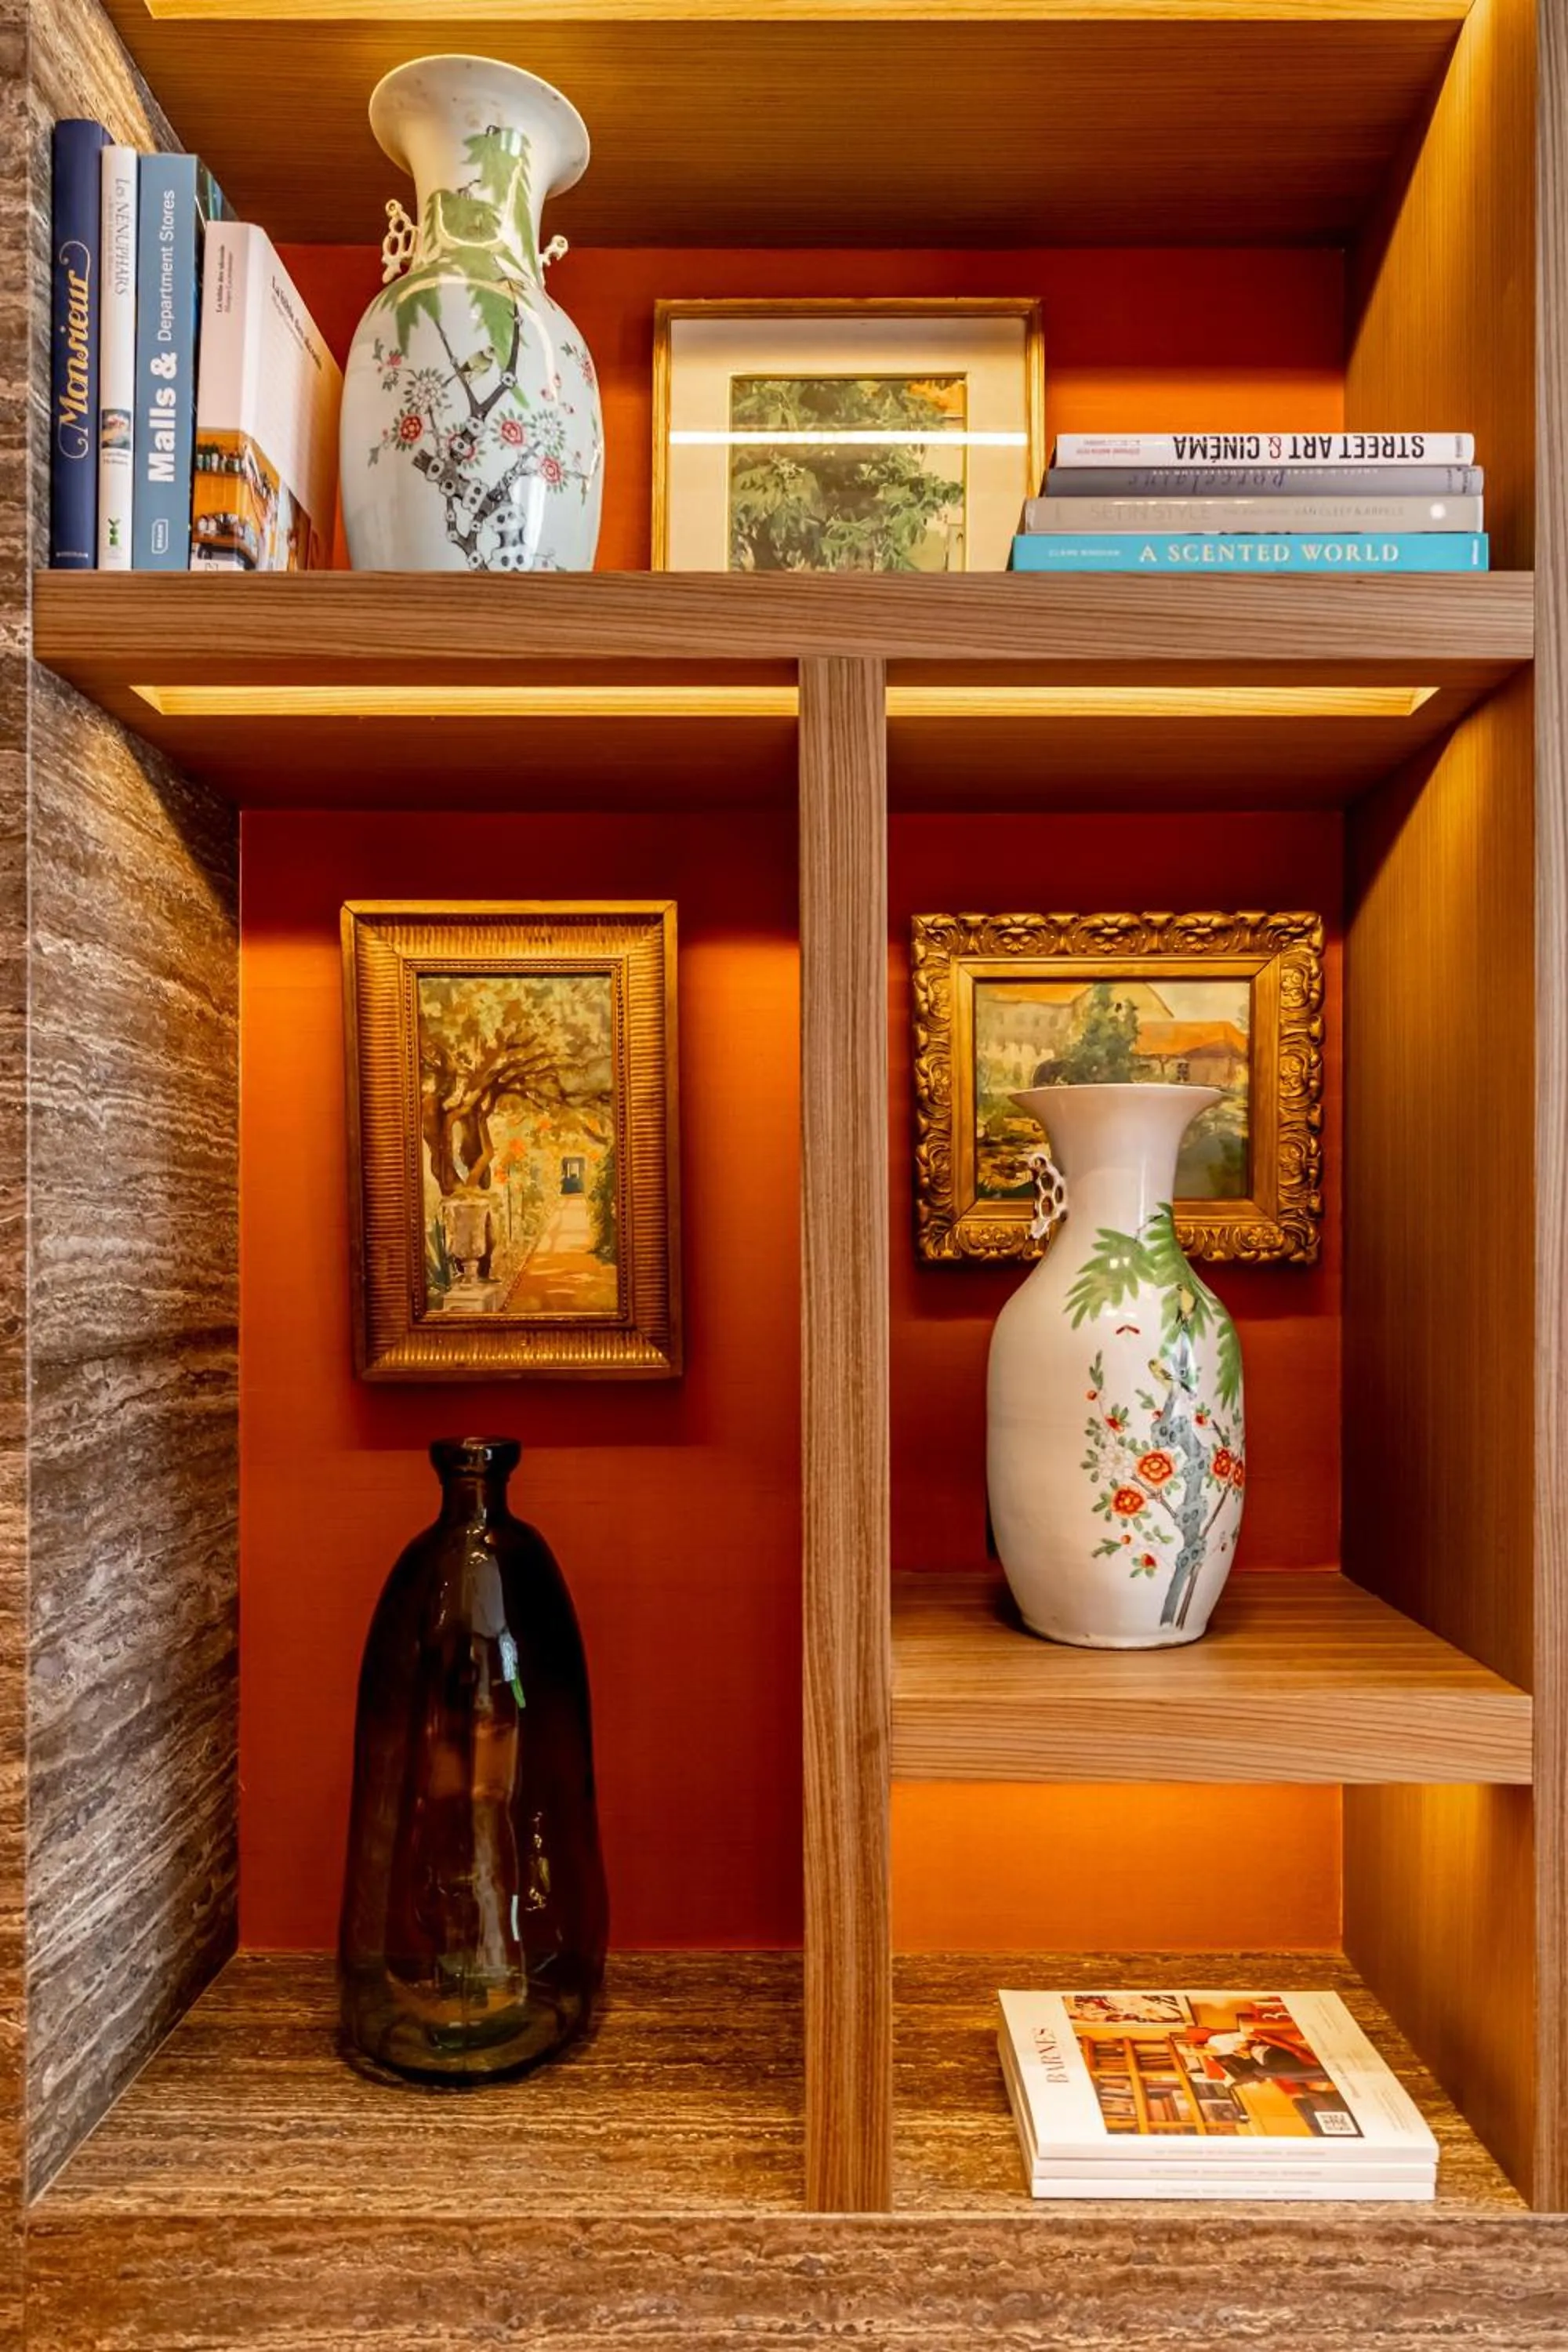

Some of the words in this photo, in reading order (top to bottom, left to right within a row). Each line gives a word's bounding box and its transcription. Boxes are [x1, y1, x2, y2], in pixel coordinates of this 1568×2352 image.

[159, 189, 176, 241] Stores
[157, 245, 176, 342] Department
[58, 241, 91, 459] Monsieur
[150, 352, 176, 379] &
[147, 387, 176, 483] Malls
[1268, 435, 1283, 460] &
[1289, 436, 1332, 460] ART
[1338, 435, 1425, 459] STREET
[1173, 436, 1260, 463] CINÉMA
[1127, 471, 1285, 493] porcelaine
[1153, 504, 1212, 521] STYLE
[1139, 545, 1158, 563] A
[1167, 543, 1290, 563] SCENTED
[1301, 543, 1399, 563] WORLD
